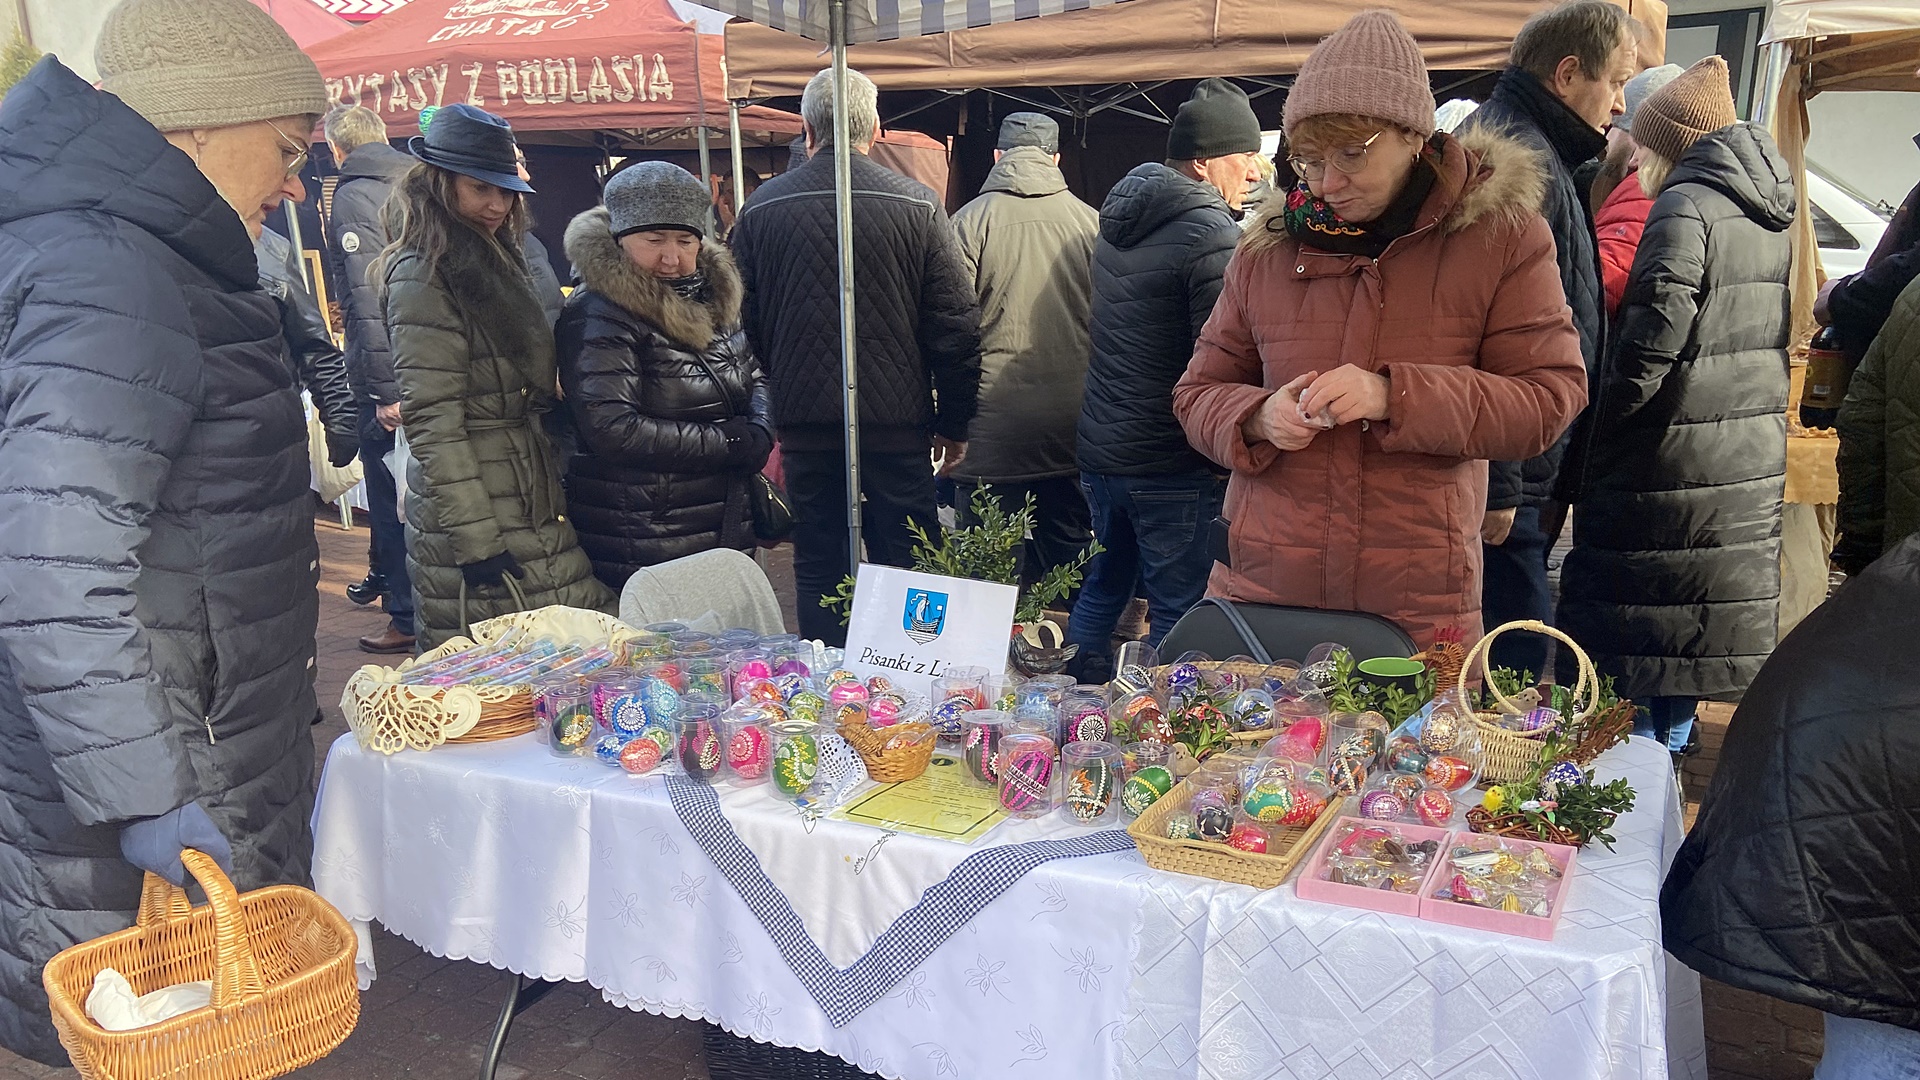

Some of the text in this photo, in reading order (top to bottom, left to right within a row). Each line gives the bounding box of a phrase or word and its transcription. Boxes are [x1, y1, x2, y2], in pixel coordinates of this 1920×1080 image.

[427, 17, 546, 43] CHATA
[324, 63, 449, 114] RYTASY
[461, 62, 485, 107] Z
[496, 53, 674, 106] PODLASIA
[858, 646, 914, 672] Pisanki
[913, 662, 926, 674] z
